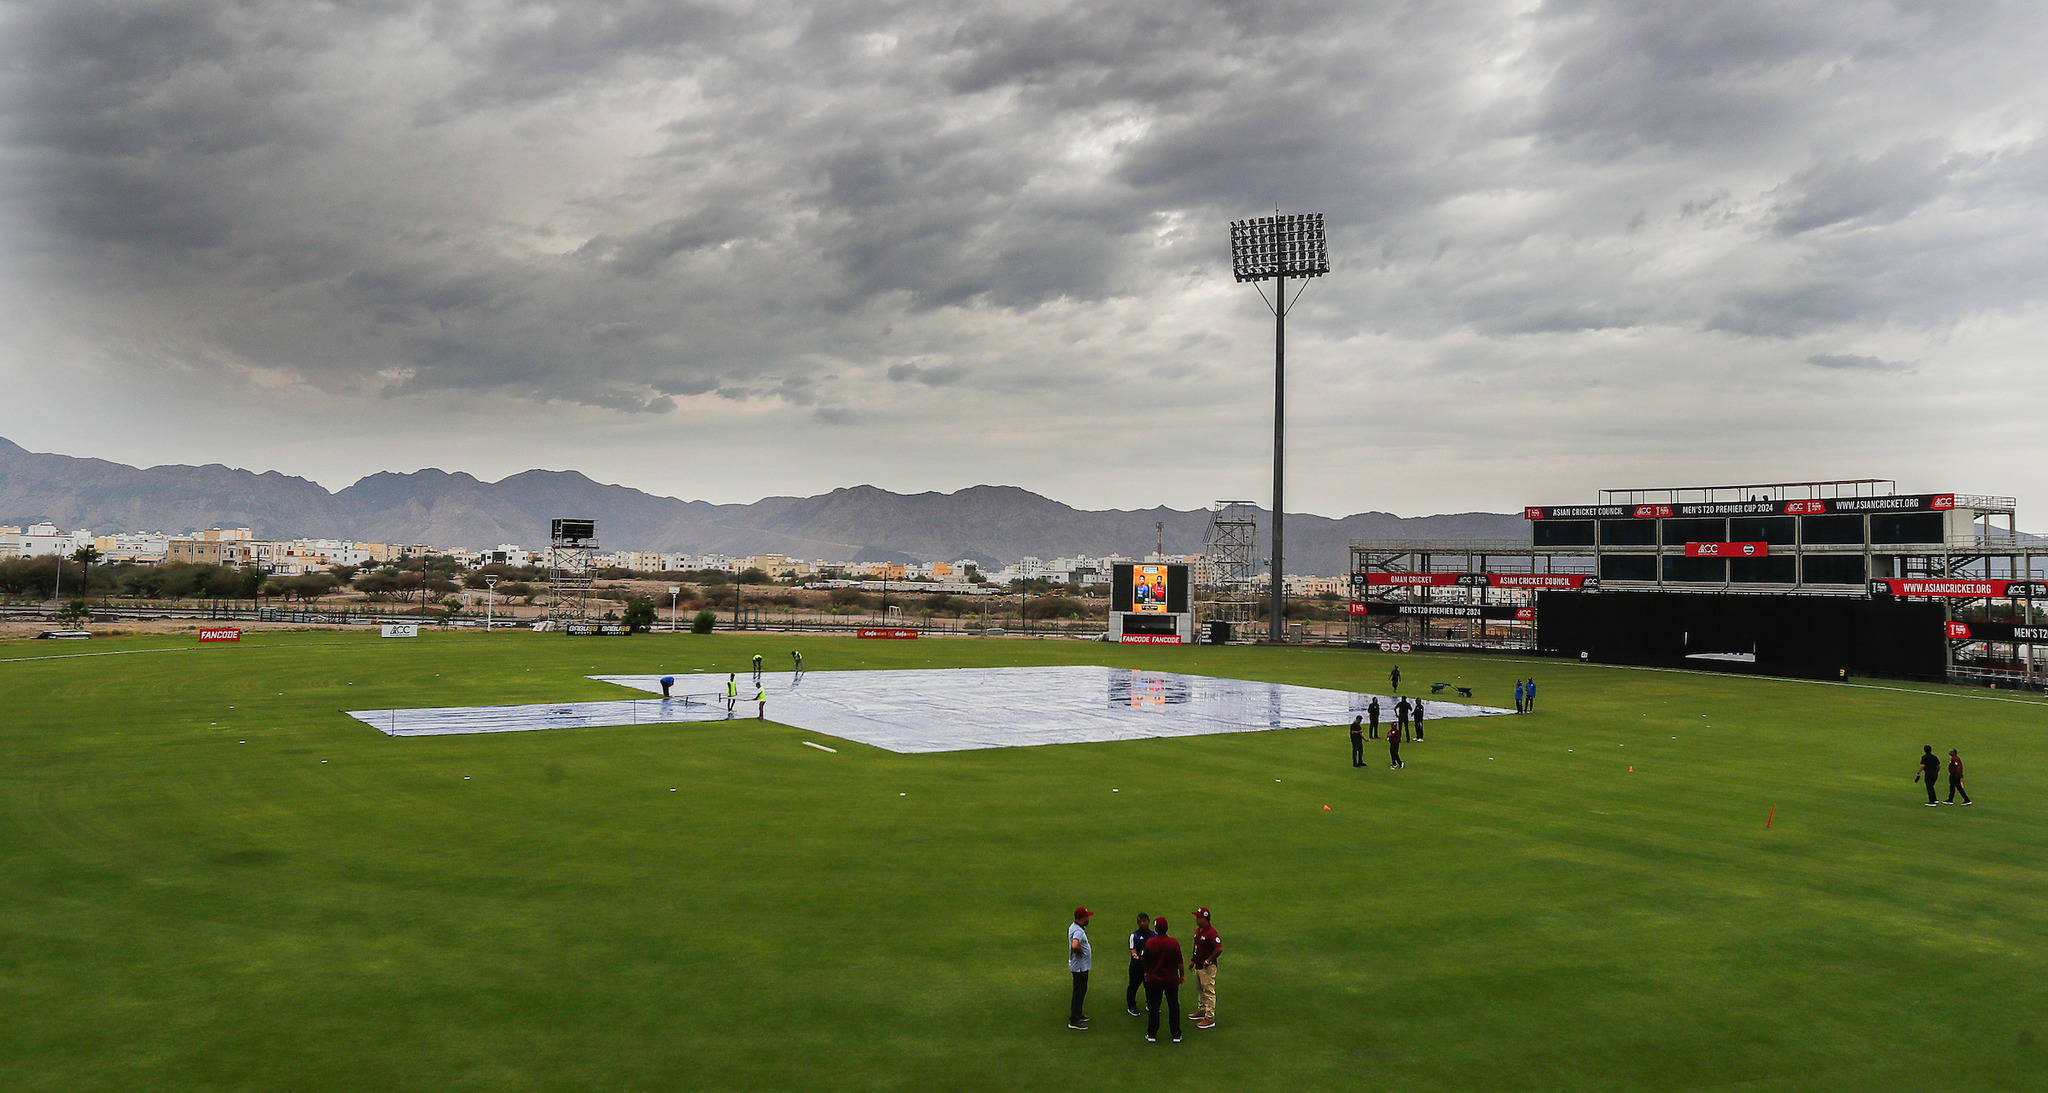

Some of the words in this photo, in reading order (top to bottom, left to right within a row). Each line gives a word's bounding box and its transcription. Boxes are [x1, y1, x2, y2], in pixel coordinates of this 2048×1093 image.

[1788, 502, 1803, 510] ACC
[1836, 498, 1919, 510] WWW.ASIANCRICKET.ORG
[1934, 498, 1952, 506] ACC
[1682, 506, 1702, 514] MEN'S
[1702, 506, 1714, 514] T20
[1715, 505, 1742, 513] PREMIER
[1744, 504, 1756, 512] CUP
[1757, 504, 1773, 512] 2024
[1698, 544, 1718, 553] ACC
[1903, 583, 1991, 594] WWW.ASIANCRICKET.ORG
[2008, 585, 2026, 594] ACC
[390, 626, 410, 634] ACC
[2014, 627, 2038, 638] MEN'S
[2038, 628, 2048, 639] T2
